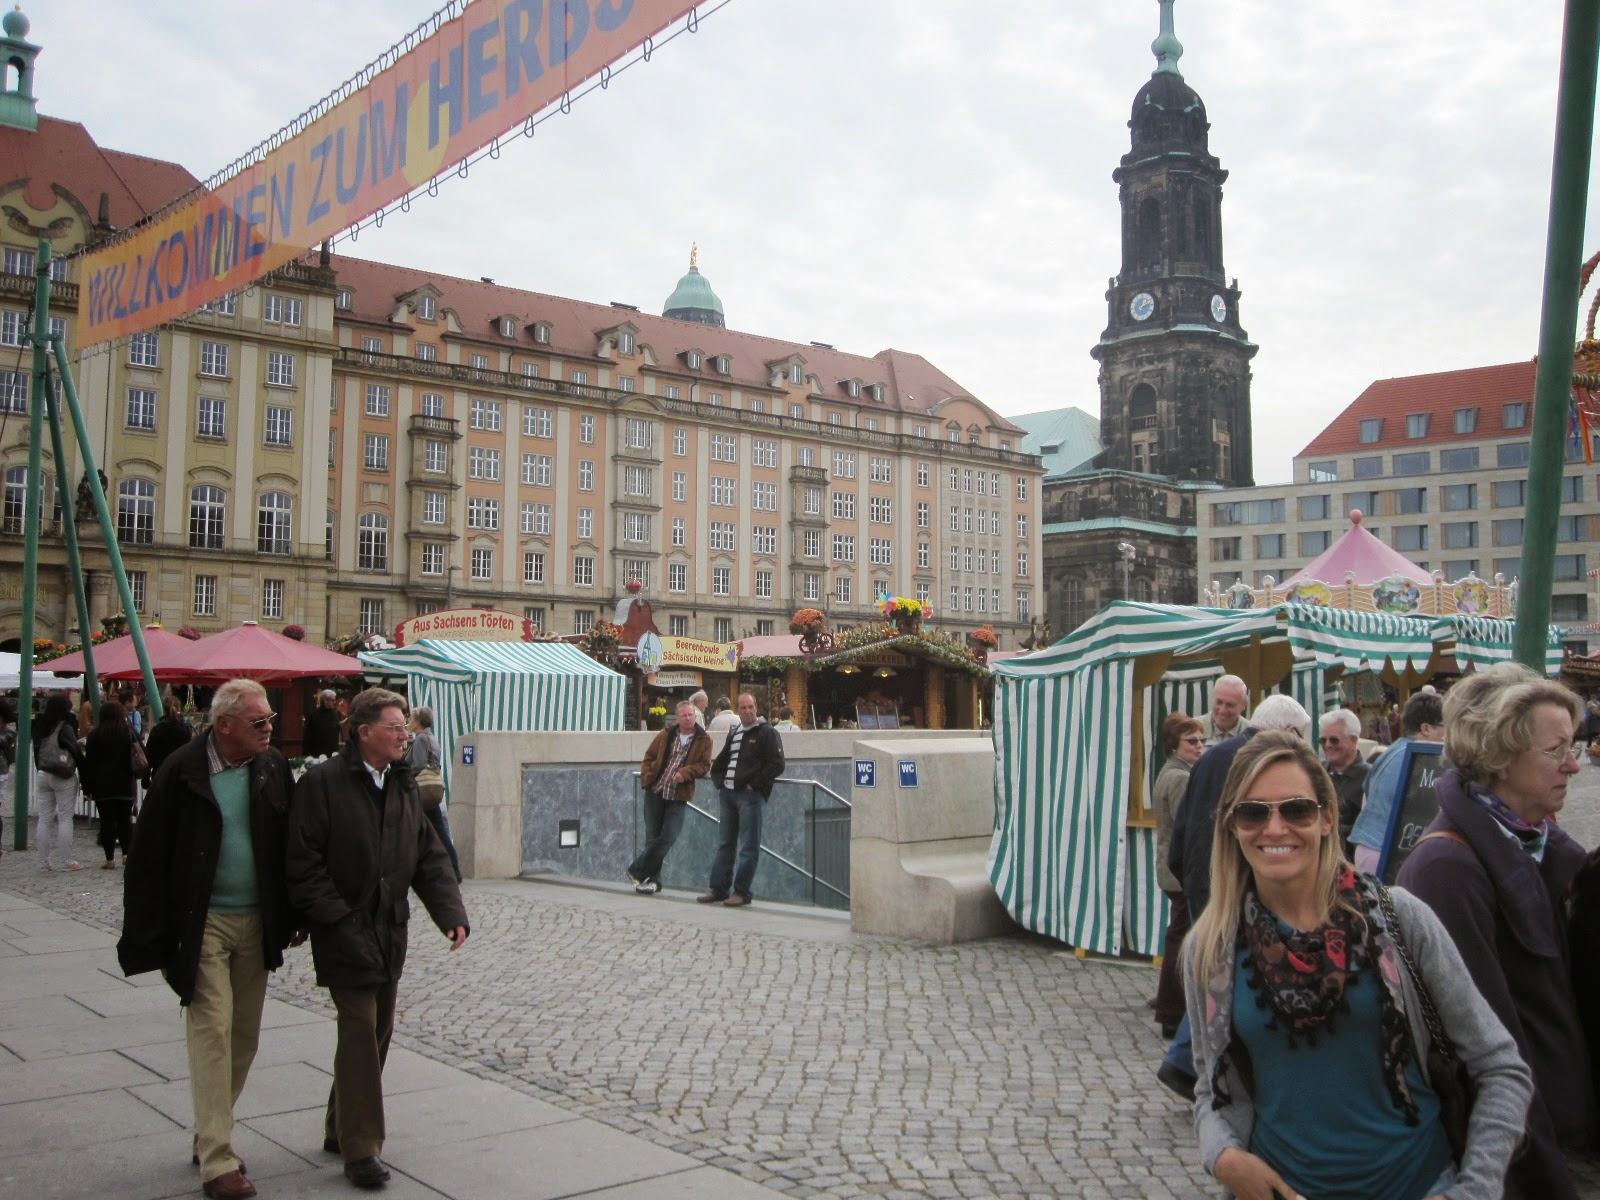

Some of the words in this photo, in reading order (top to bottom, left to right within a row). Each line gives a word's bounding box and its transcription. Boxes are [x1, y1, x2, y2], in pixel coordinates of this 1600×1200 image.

[88, 160, 295, 327] WILLKOMMEN
[307, 82, 408, 226] ZUM
[413, 620, 431, 633] Aus
[433, 614, 477, 629] Sachsens
[480, 613, 514, 631] Töpfen
[675, 640, 720, 655] Beerenbowle
[663, 651, 702, 664] Sächsische
[703, 656, 724, 666] Weine
[463, 747, 473, 755] WC
[857, 763, 873, 773] WC
[901, 764, 915, 773] WC
